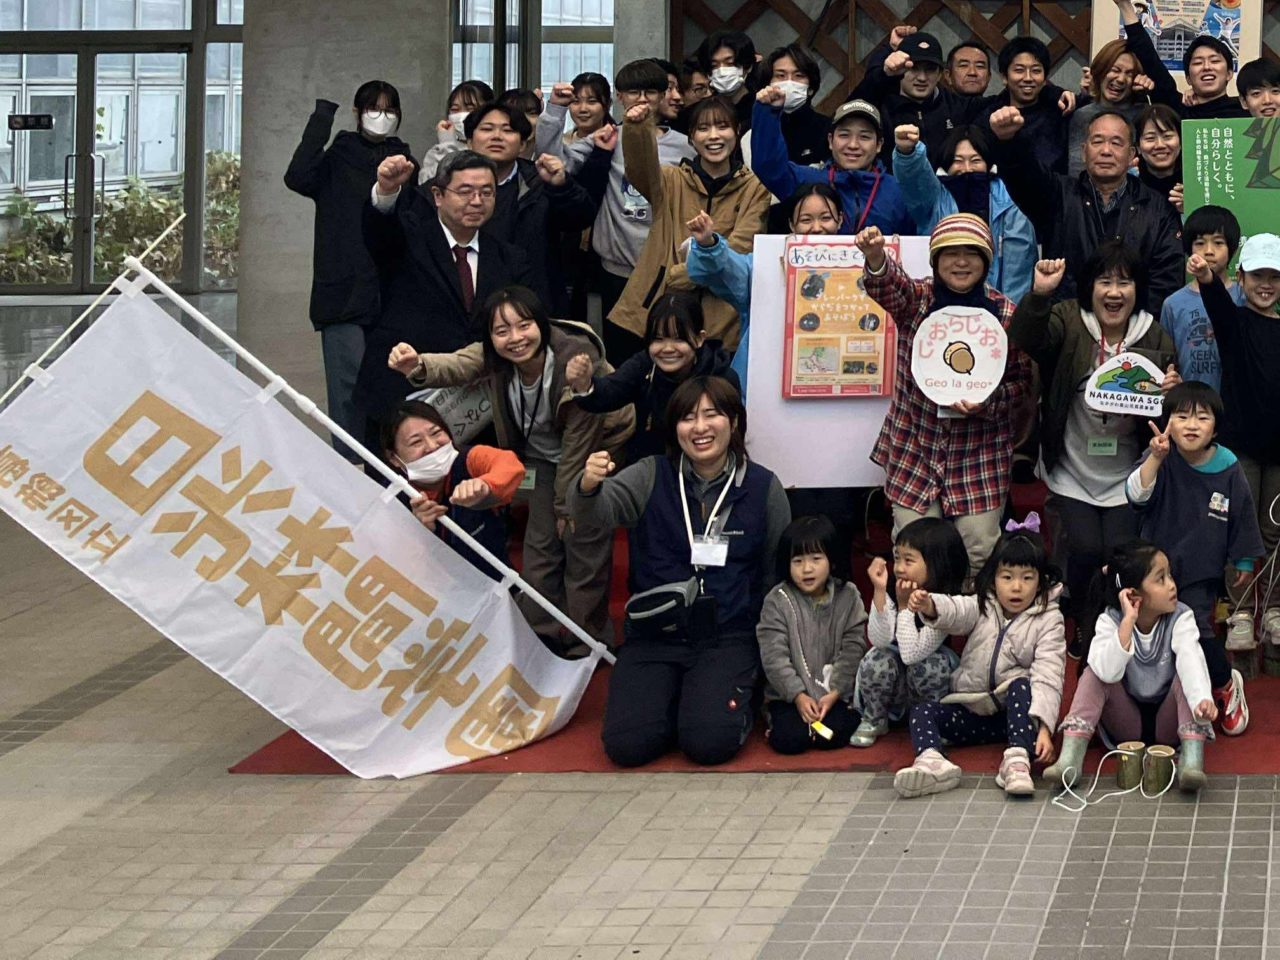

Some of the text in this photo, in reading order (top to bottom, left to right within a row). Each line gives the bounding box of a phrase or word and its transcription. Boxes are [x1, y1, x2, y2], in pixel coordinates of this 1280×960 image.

[1211, 126, 1223, 189] 自分らしく。
[1223, 126, 1236, 200] 自然とともに、
[924, 378, 948, 388] Geo
[1089, 391, 1145, 404] NAKAGAWA
